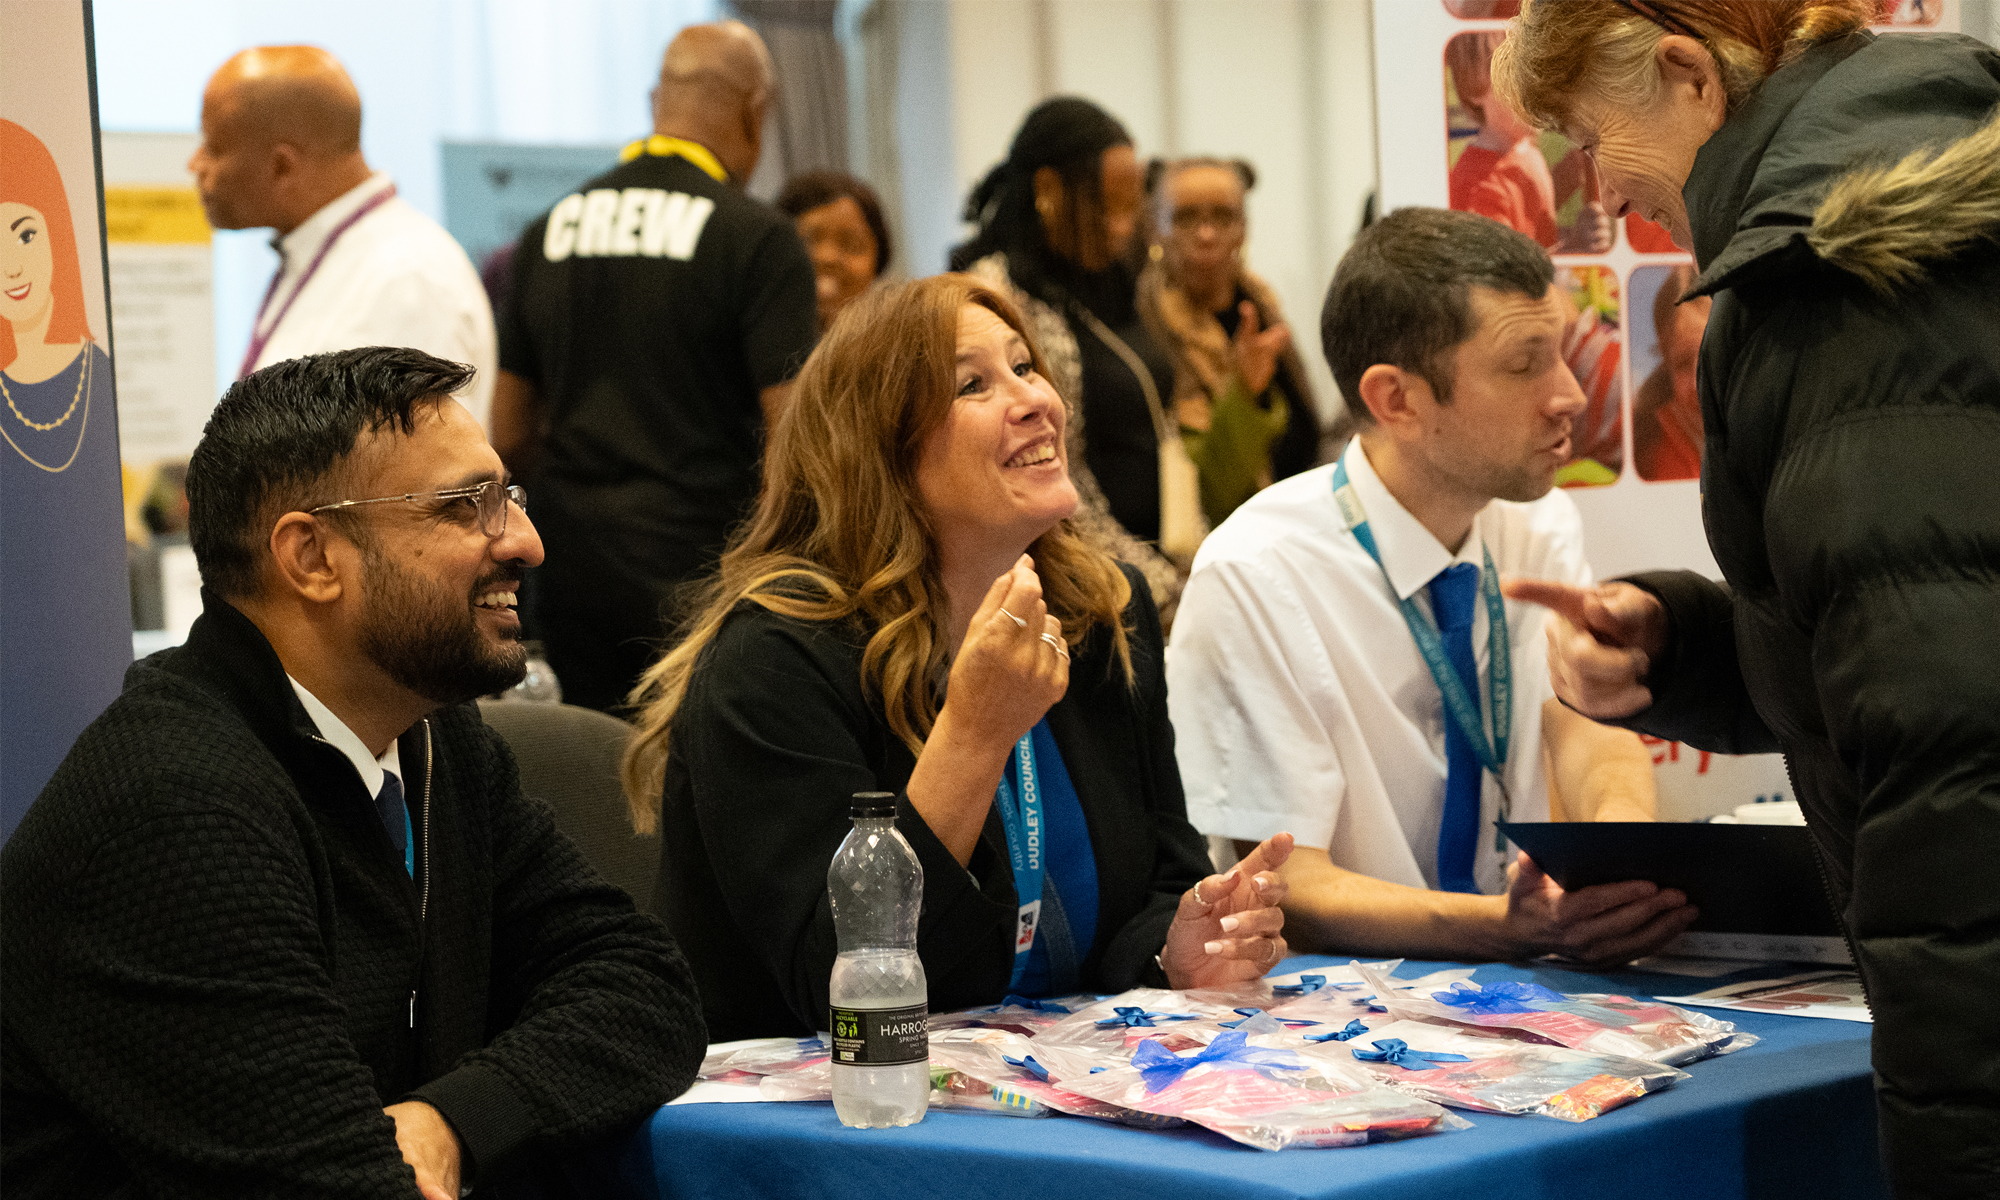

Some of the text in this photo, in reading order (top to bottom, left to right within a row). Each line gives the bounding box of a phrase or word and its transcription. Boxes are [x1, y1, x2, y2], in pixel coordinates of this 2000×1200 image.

[543, 187, 715, 263] CREW
[1020, 737, 1040, 870] DUDLEY COUNCIL
[899, 1035, 919, 1043] SPRING
